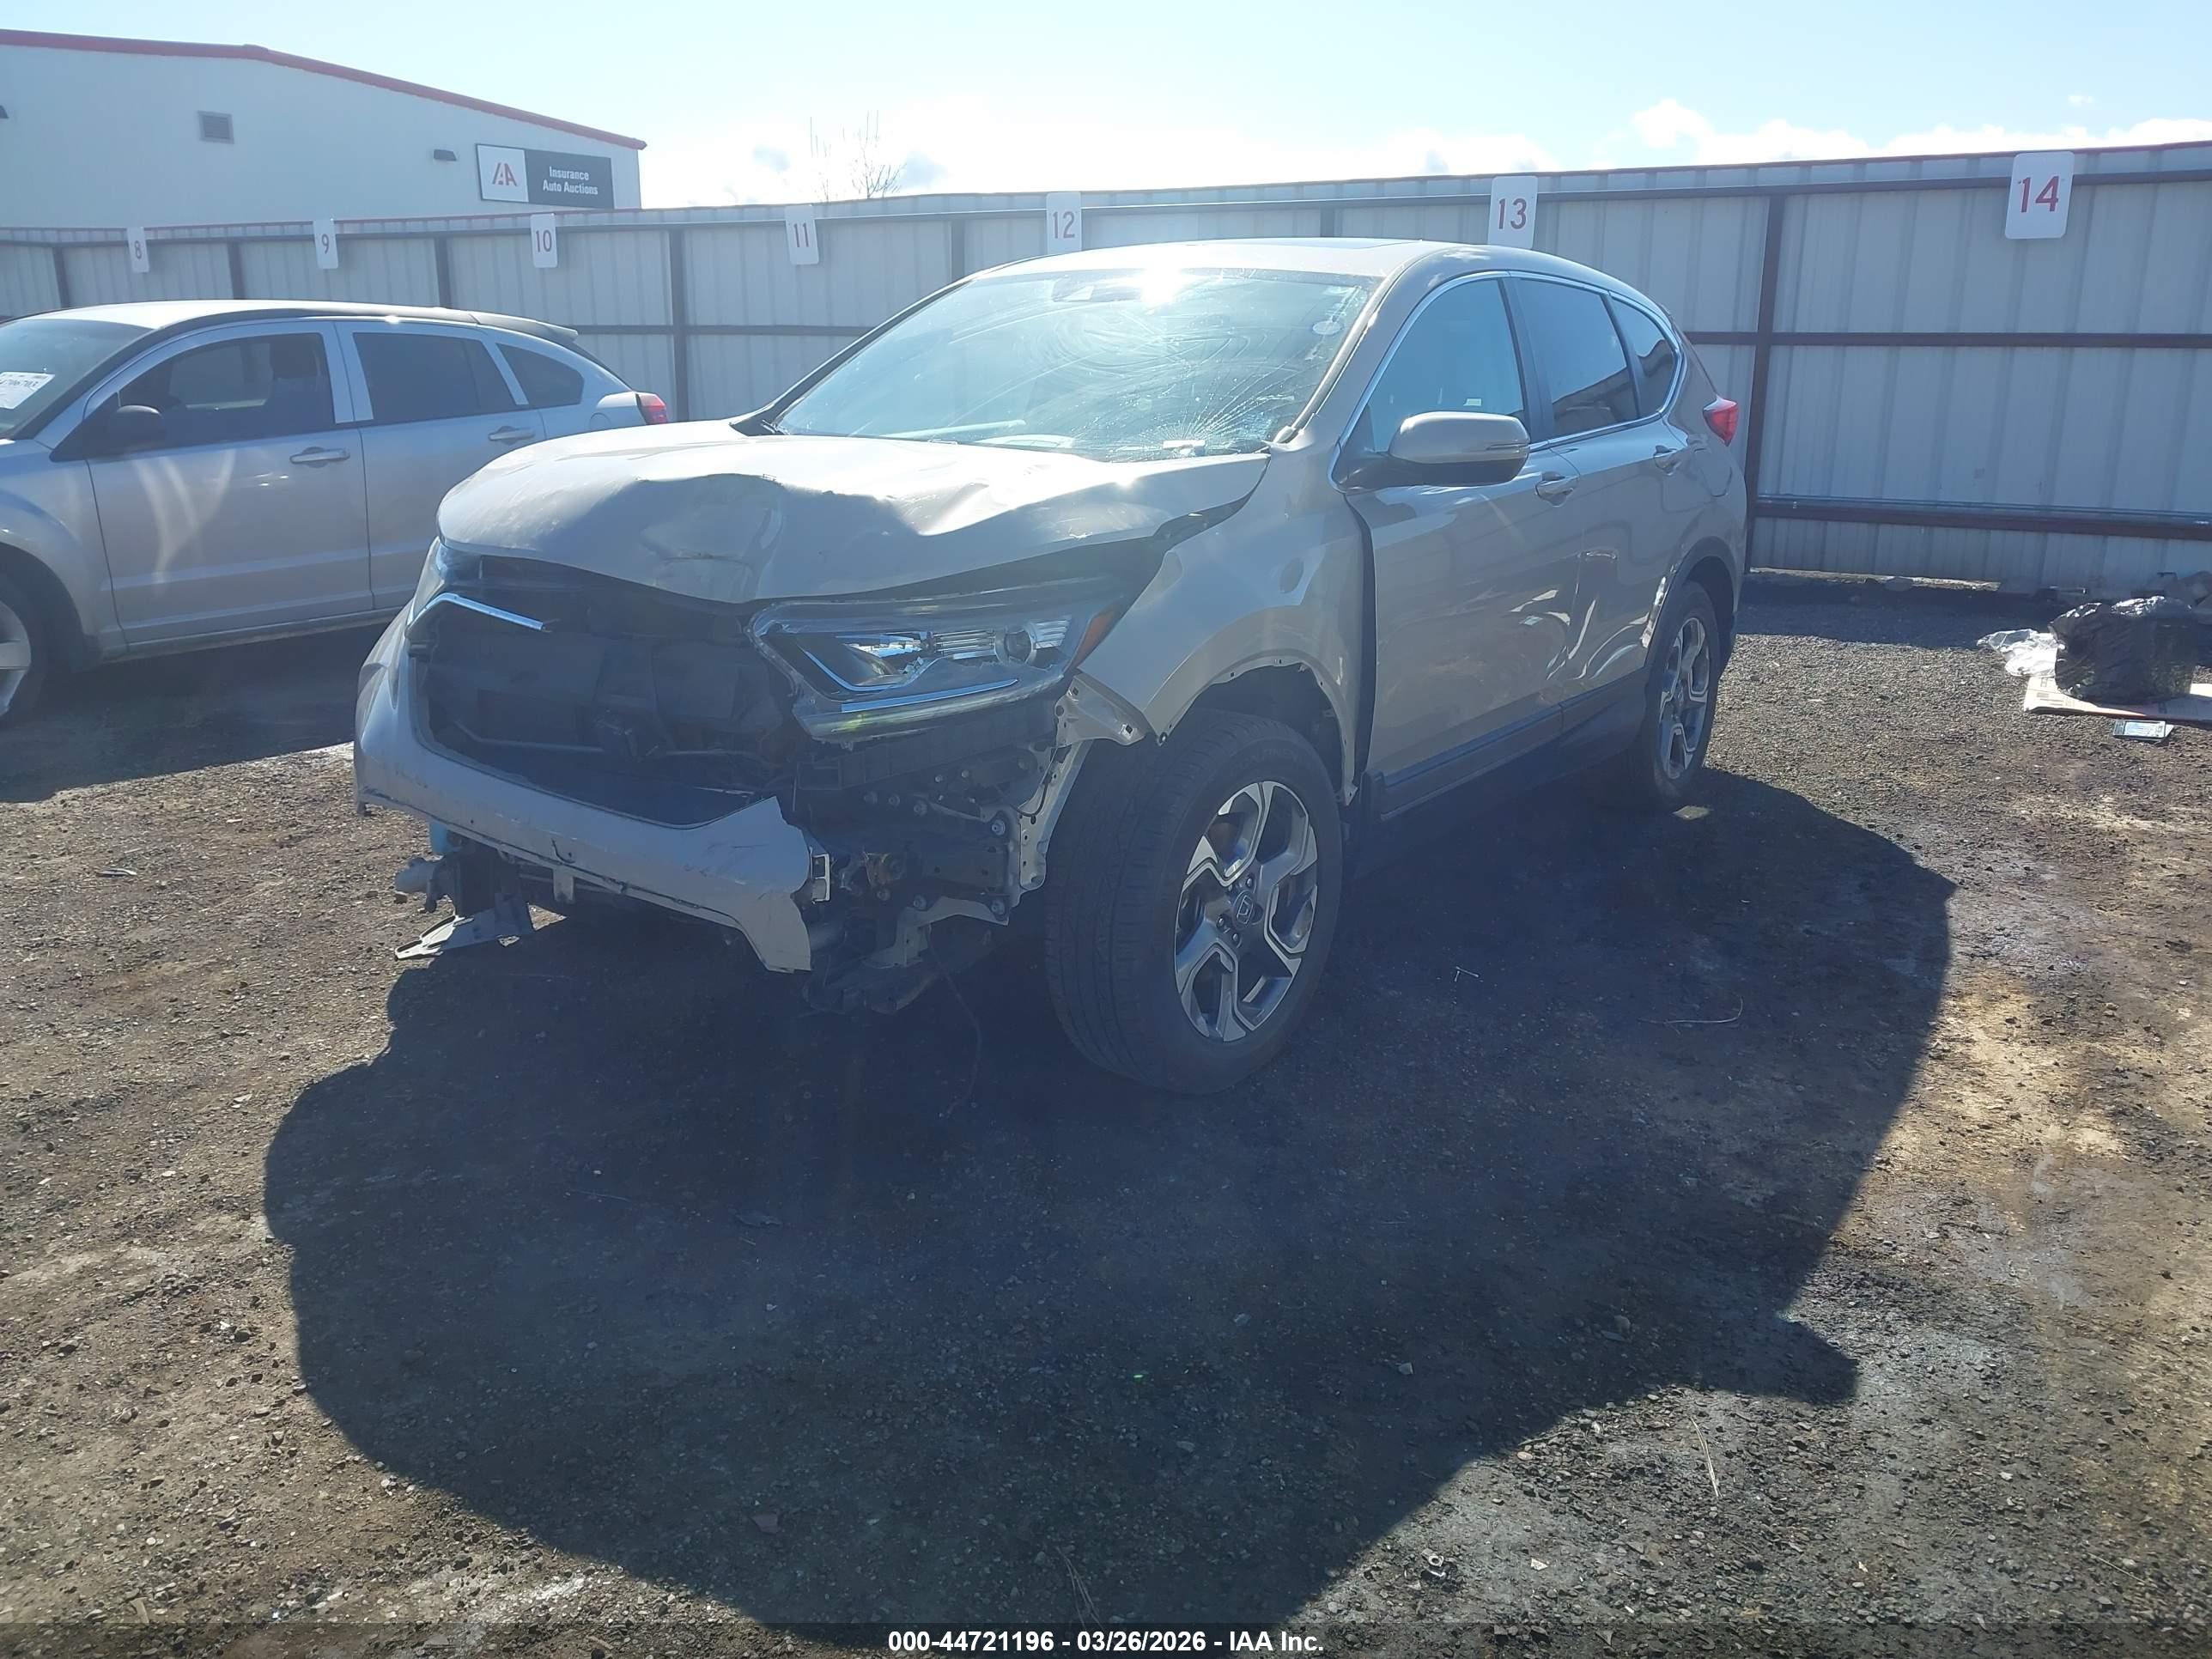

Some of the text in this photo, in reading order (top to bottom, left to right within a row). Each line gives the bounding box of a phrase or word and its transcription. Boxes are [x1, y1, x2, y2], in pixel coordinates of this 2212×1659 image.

[549, 166, 590, 181] Insurance
[543, 179, 599, 195] Auto Auctions
[2021, 175, 2059, 213] 14
[1053, 210, 1075, 239] 12
[1498, 198, 1527, 230] 13
[321, 234, 330, 255] 9
[536, 229, 552, 252] 10
[793, 222, 810, 248] 11
[134, 240, 143, 260] 8
